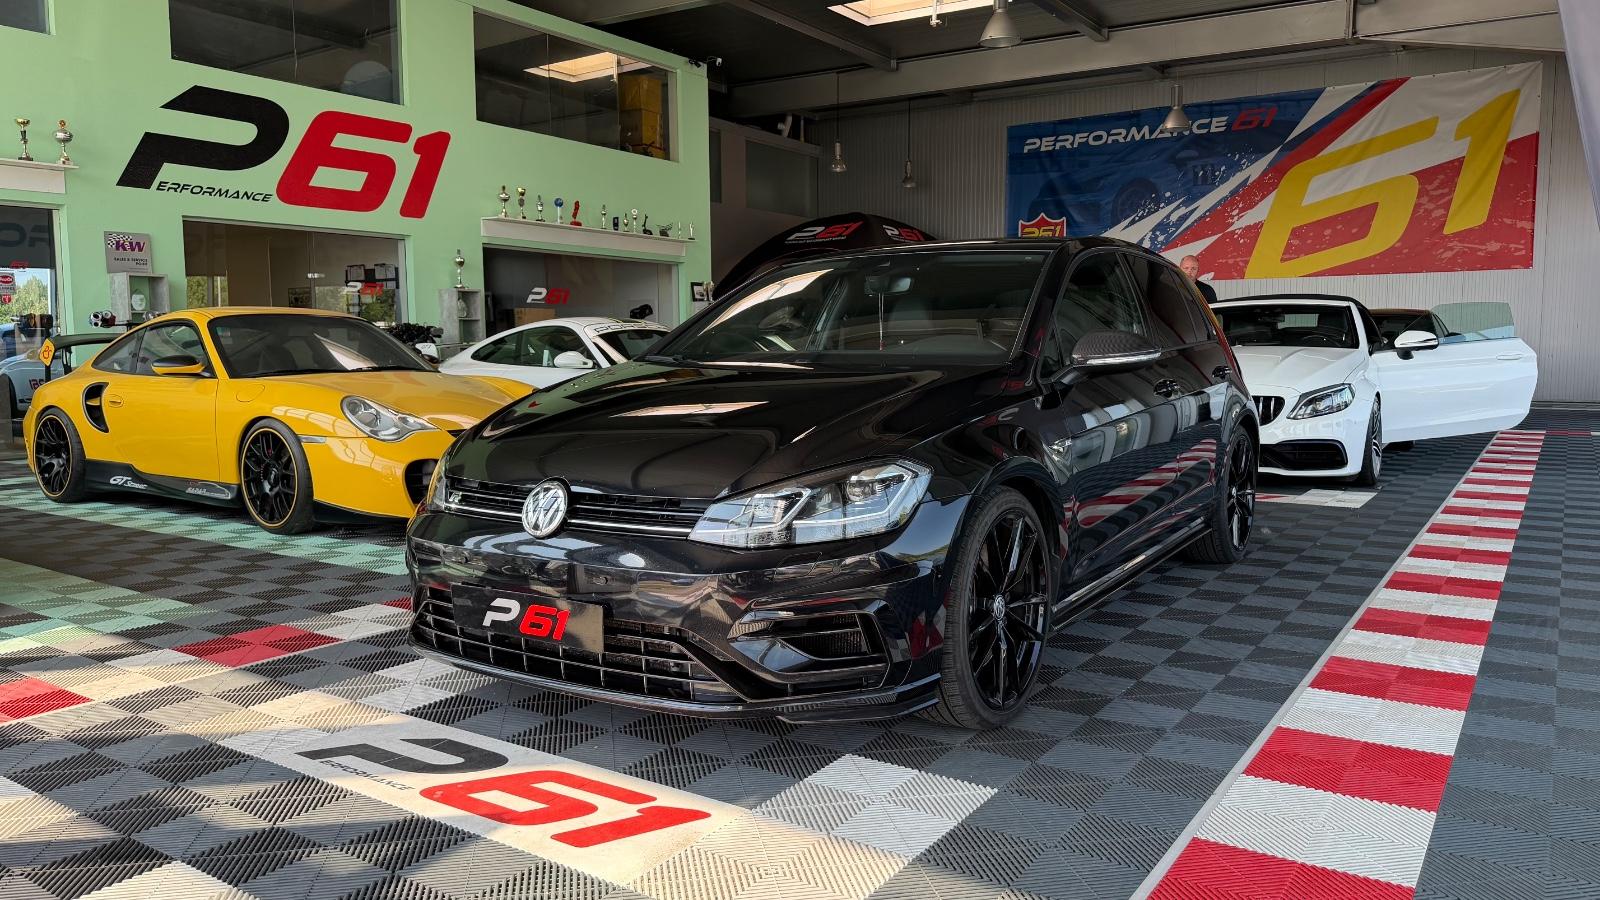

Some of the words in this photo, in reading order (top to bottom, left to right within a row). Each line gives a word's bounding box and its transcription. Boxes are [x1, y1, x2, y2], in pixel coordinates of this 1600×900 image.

[1232, 106, 1278, 130] 61
[1245, 89, 1521, 279] 61
[785, 221, 864, 240] P61
[526, 287, 571, 304] P61
[110, 476, 132, 485] GT
